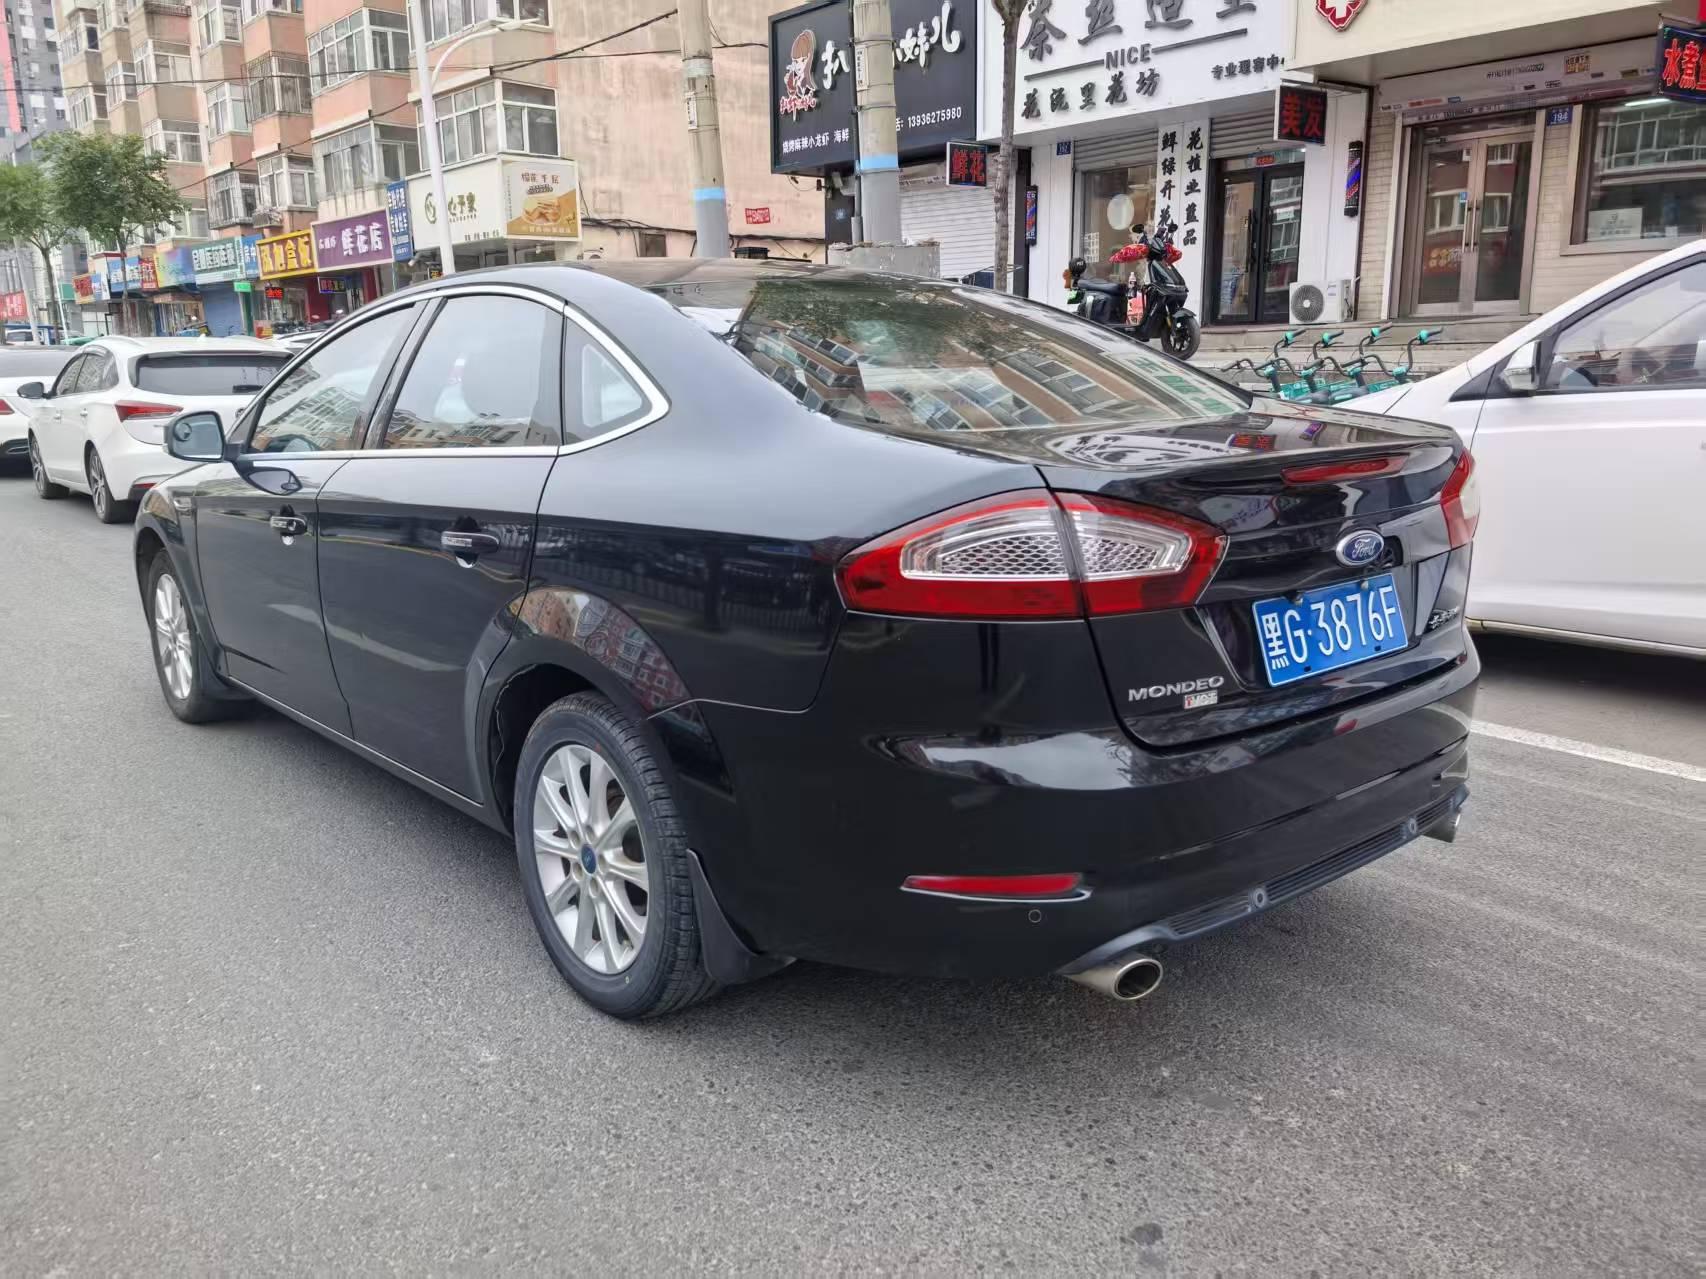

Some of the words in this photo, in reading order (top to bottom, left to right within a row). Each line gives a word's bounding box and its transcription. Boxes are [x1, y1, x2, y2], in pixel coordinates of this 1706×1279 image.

[1105, 43, 1152, 69] NICE
[1211, 53, 1285, 80] 专业理容中
[907, 106, 962, 129] 13936275980
[1552, 112, 1569, 122] 194
[833, 127, 850, 143] 海鲜
[1352, 537, 1377, 559] Ford
[1128, 675, 1225, 702] MONDEO
